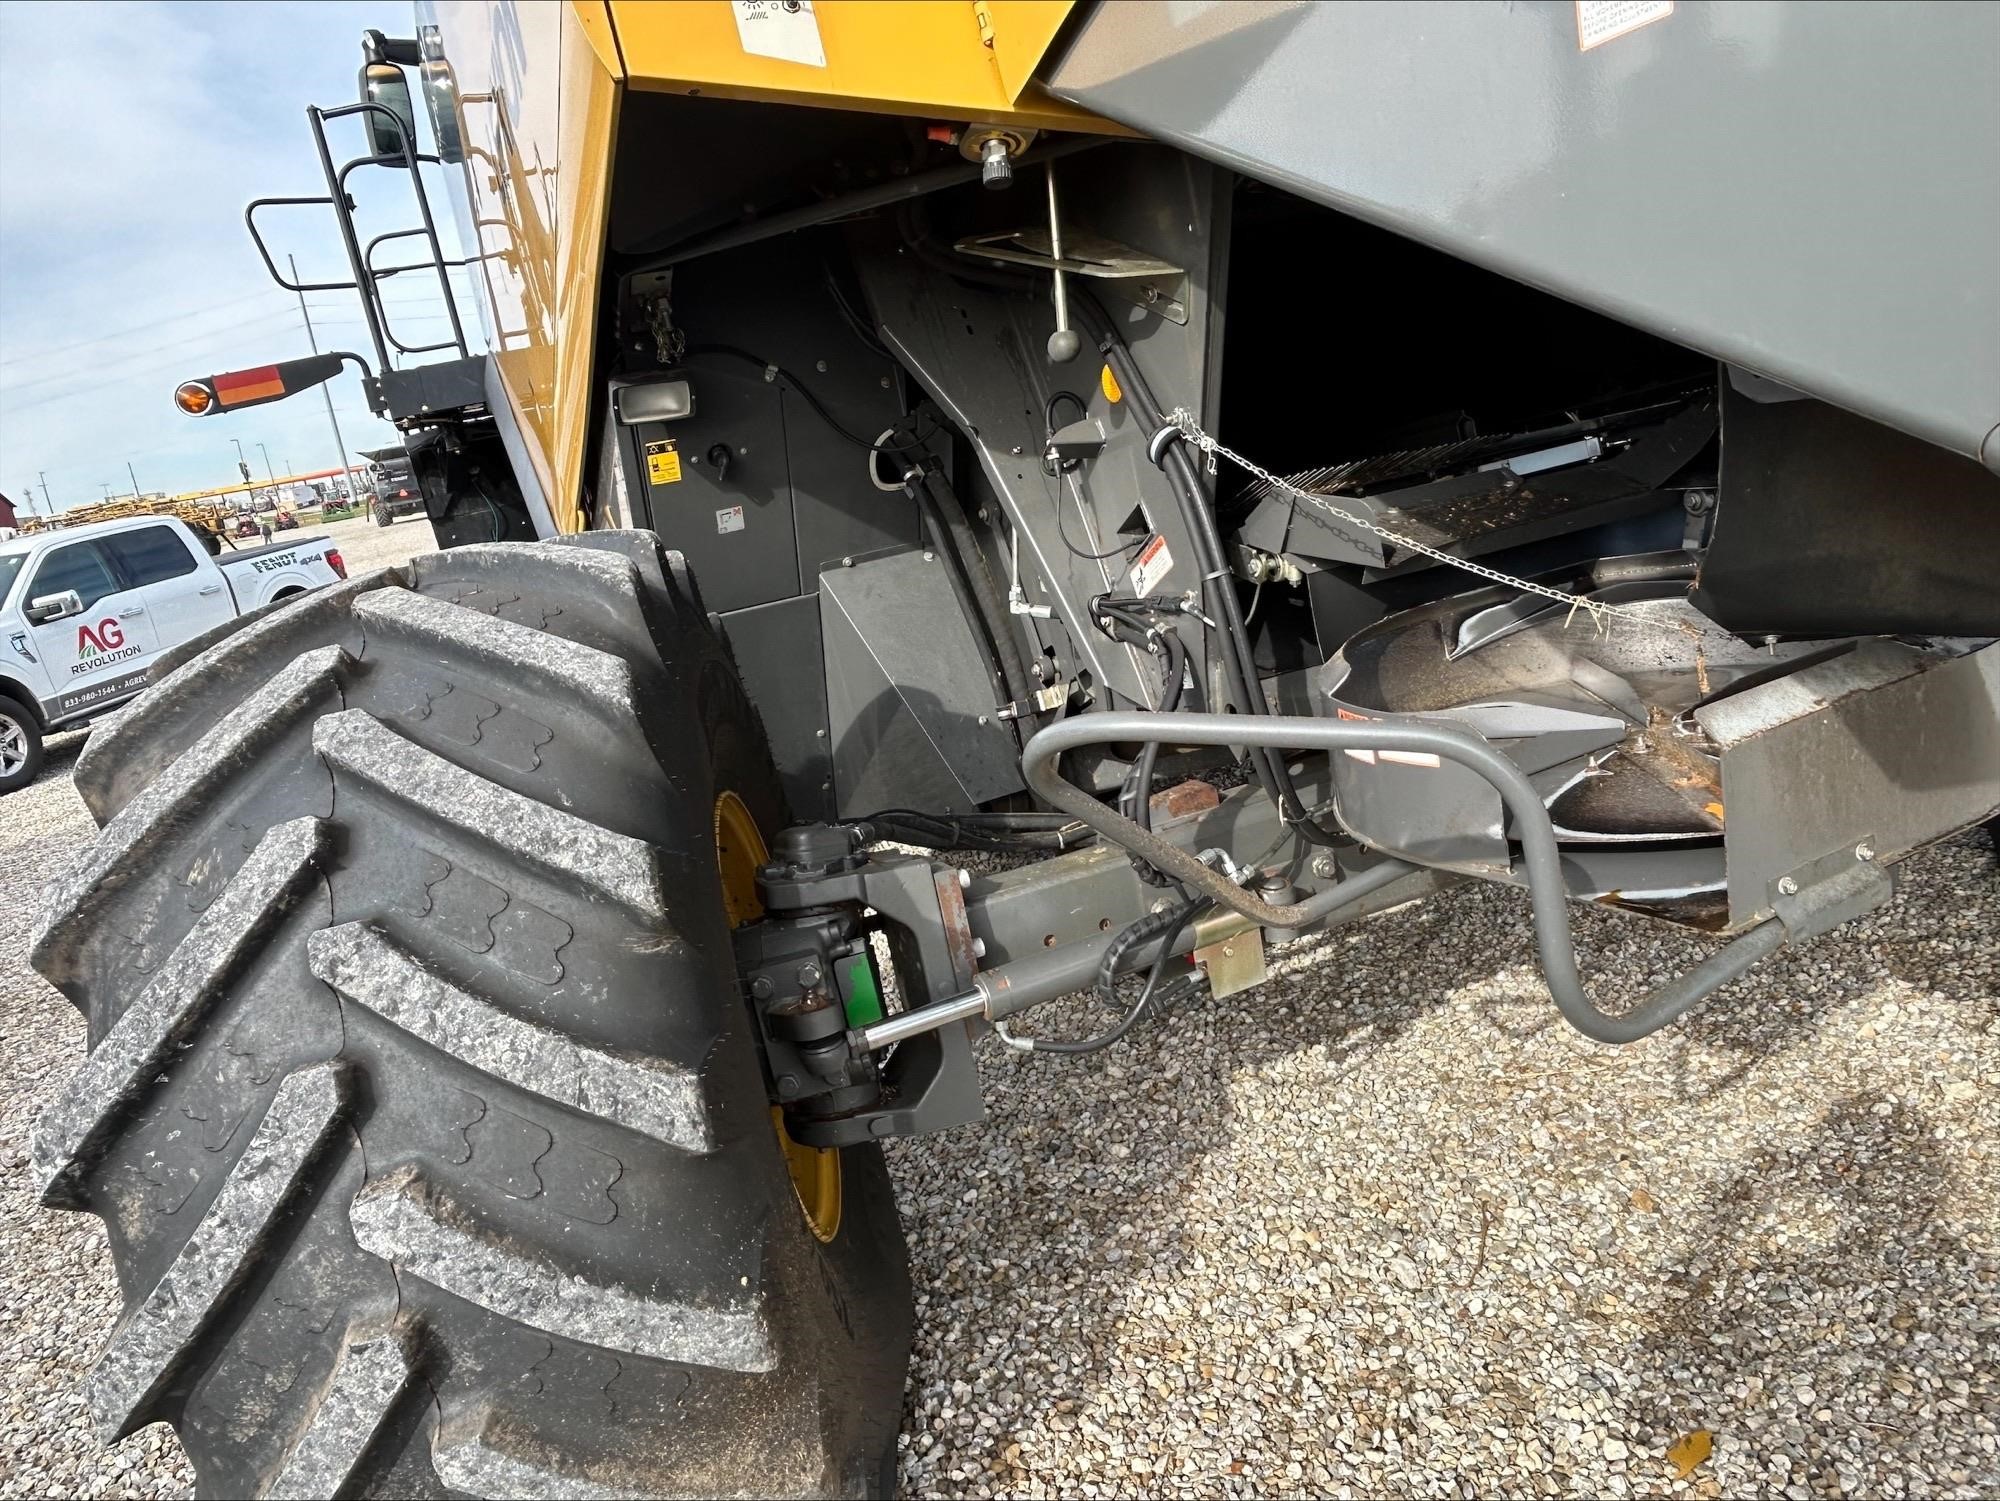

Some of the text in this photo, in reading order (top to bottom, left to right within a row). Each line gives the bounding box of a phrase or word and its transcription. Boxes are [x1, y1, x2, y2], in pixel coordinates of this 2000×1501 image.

[250, 551, 298, 573] FENDT
[78, 618, 124, 660] AG
[71, 644, 142, 675] REVOLUTION
